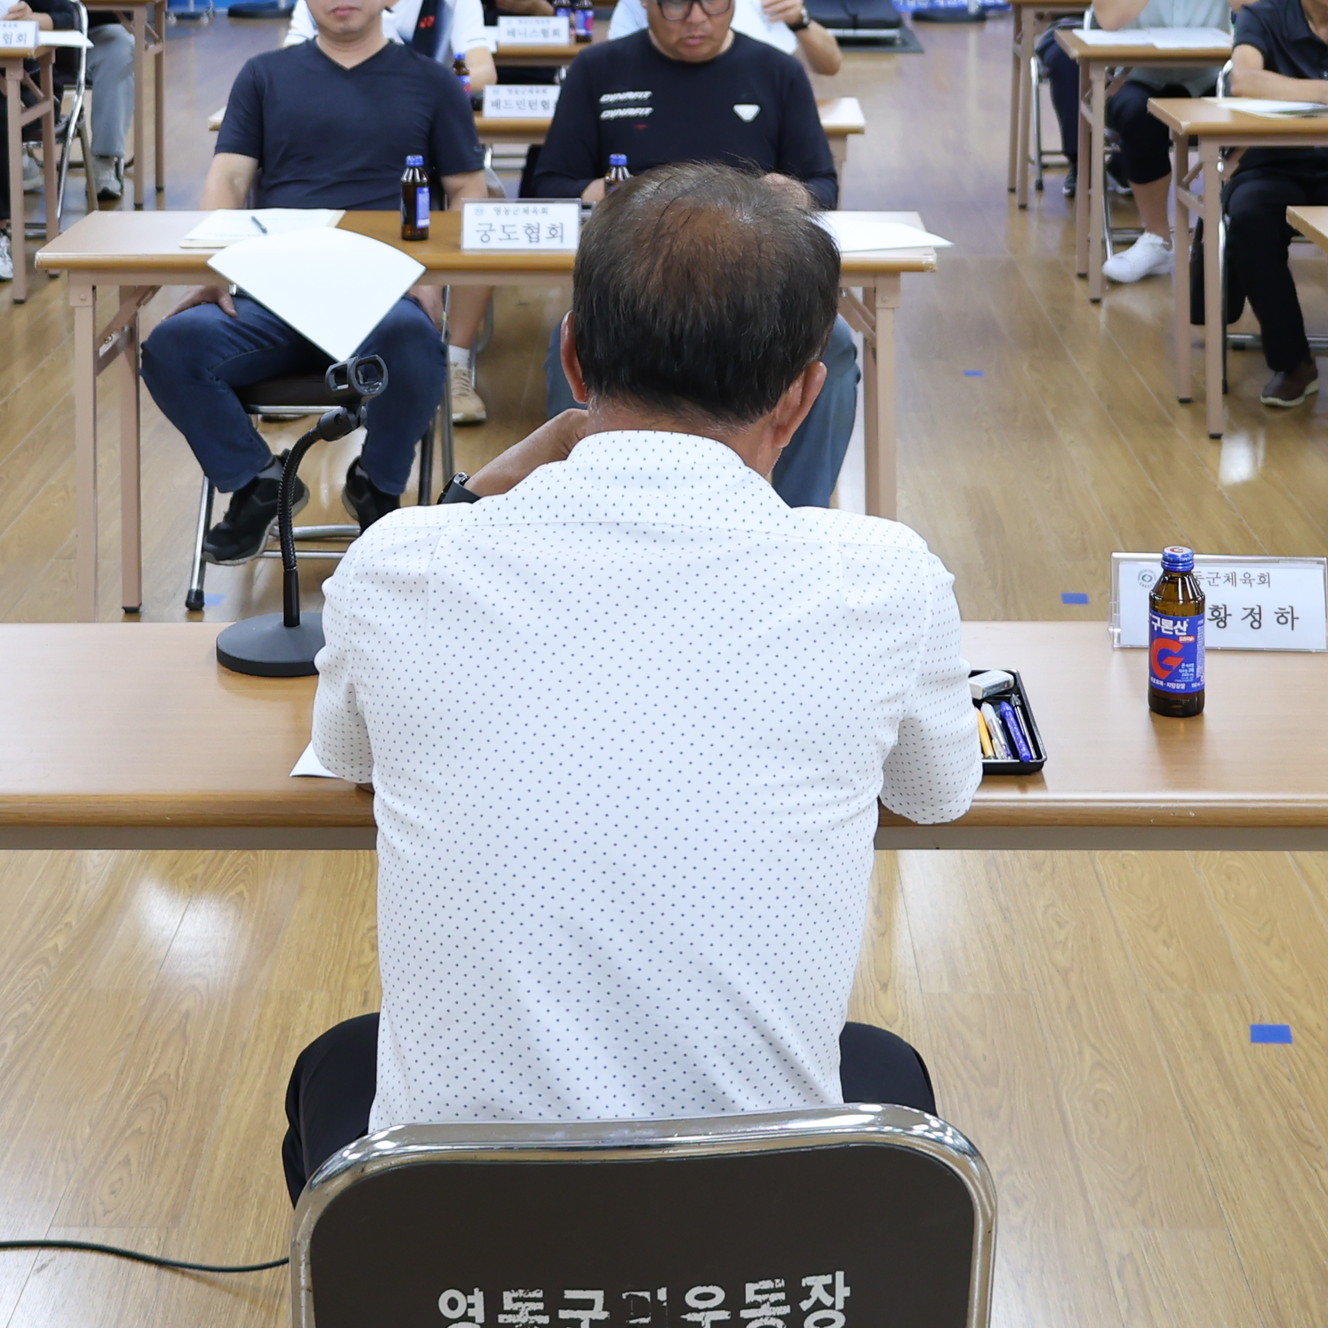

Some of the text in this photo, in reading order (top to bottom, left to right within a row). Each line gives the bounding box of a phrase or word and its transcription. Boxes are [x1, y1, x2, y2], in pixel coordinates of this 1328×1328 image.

[490, 98, 557, 112] 배드민턴협
[475, 221, 565, 244] 궁도협회
[1151, 615, 1189, 636] 구론산
